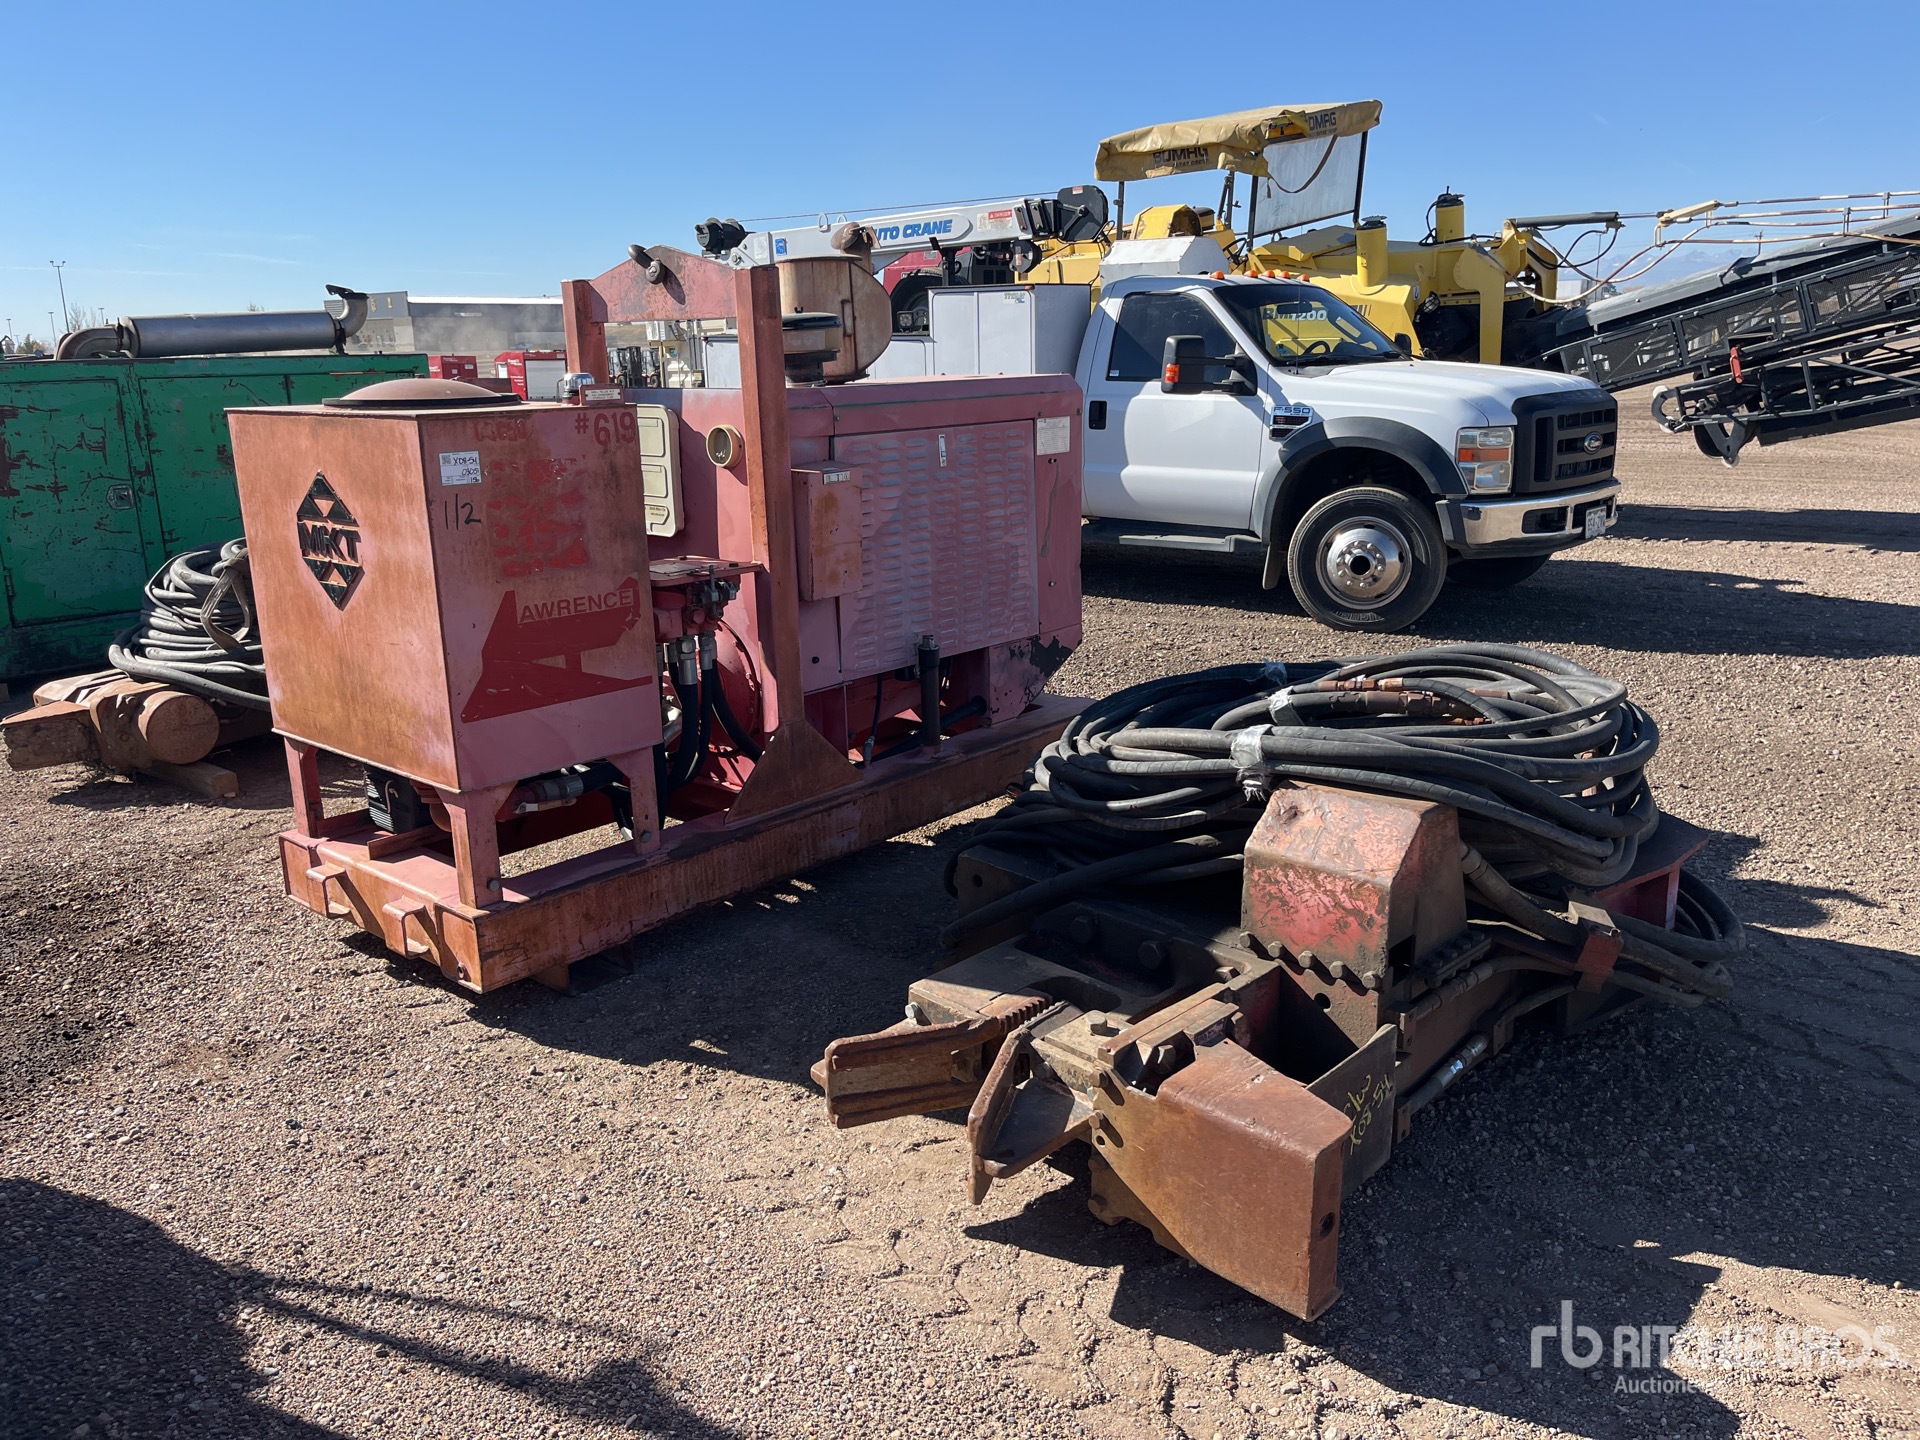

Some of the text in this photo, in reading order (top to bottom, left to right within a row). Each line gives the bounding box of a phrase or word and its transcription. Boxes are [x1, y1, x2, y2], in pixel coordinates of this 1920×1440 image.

[1308, 111, 1337, 131] OMAG
[903, 219, 953, 239] CRANE
[297, 521, 362, 564] MKT
